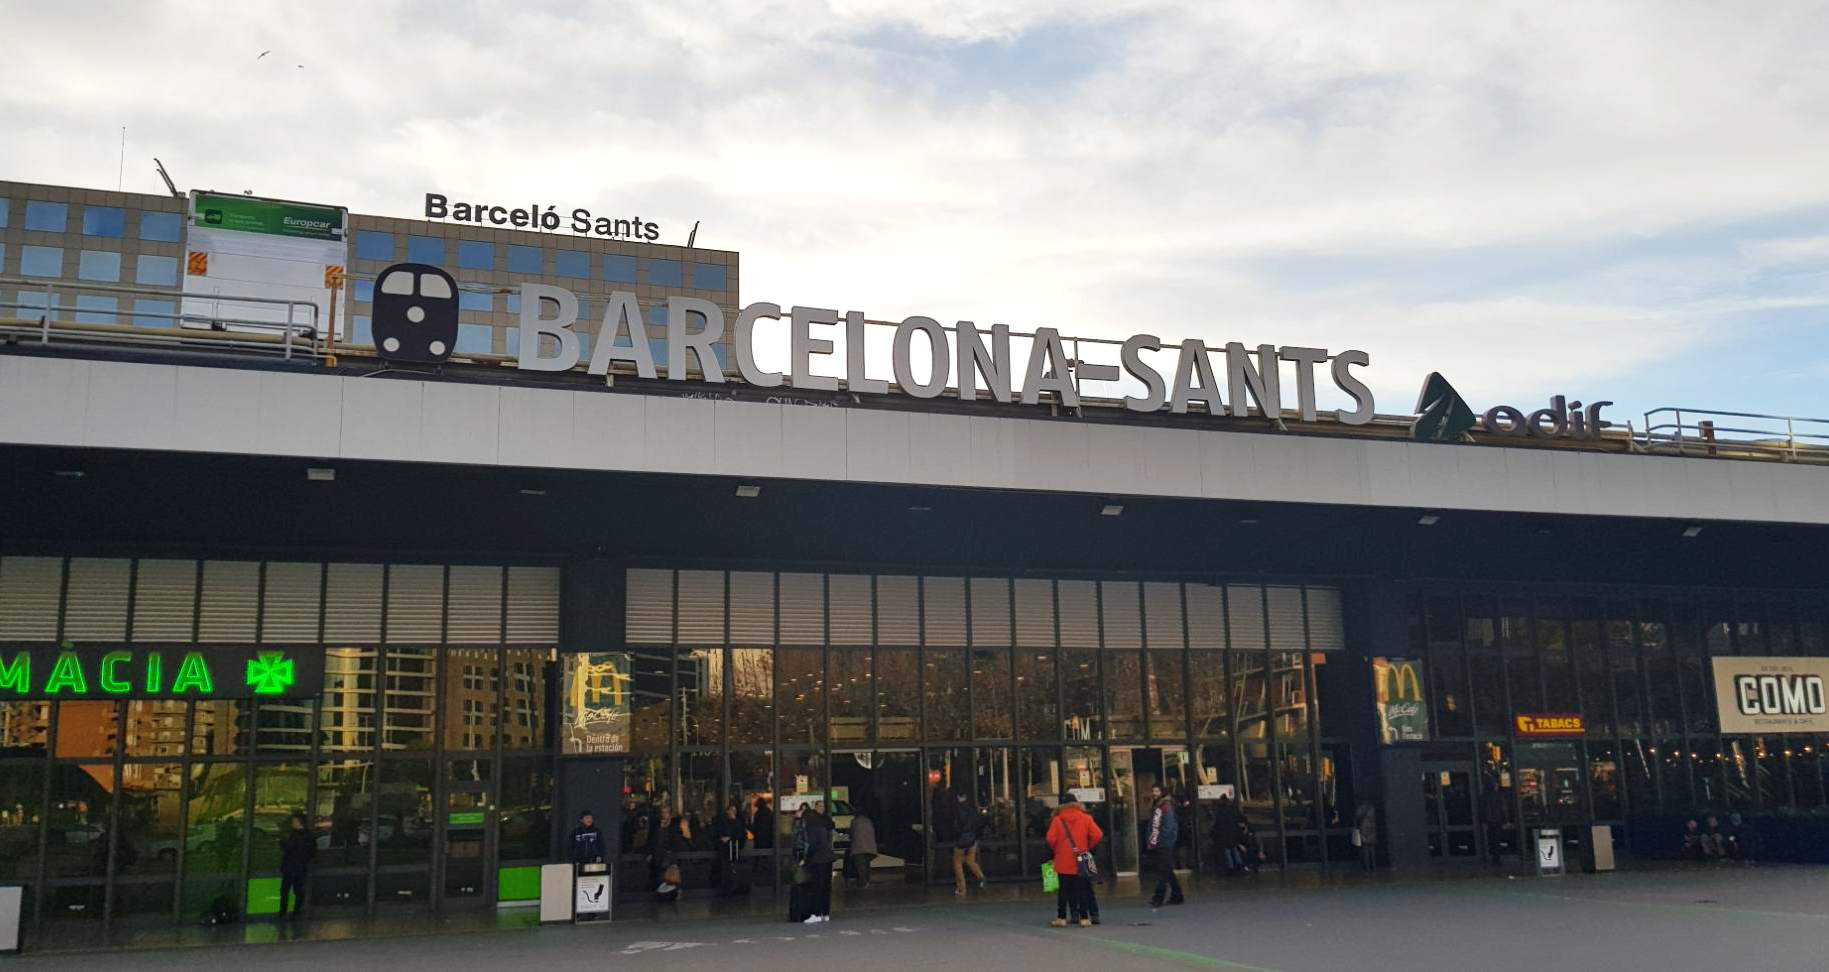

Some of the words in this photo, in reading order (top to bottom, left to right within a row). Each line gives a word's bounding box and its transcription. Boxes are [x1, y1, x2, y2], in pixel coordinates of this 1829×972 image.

[283, 216, 331, 229] Europcar
[425, 193, 560, 230] Barceló
[571, 208, 660, 241] Sants
[1736, 675, 1826, 715] COMO
[1535, 717, 1581, 729] TABACS
[586, 733, 610, 744] Dentro
[586, 744, 593, 752] la
[594, 744, 623, 753] estación
